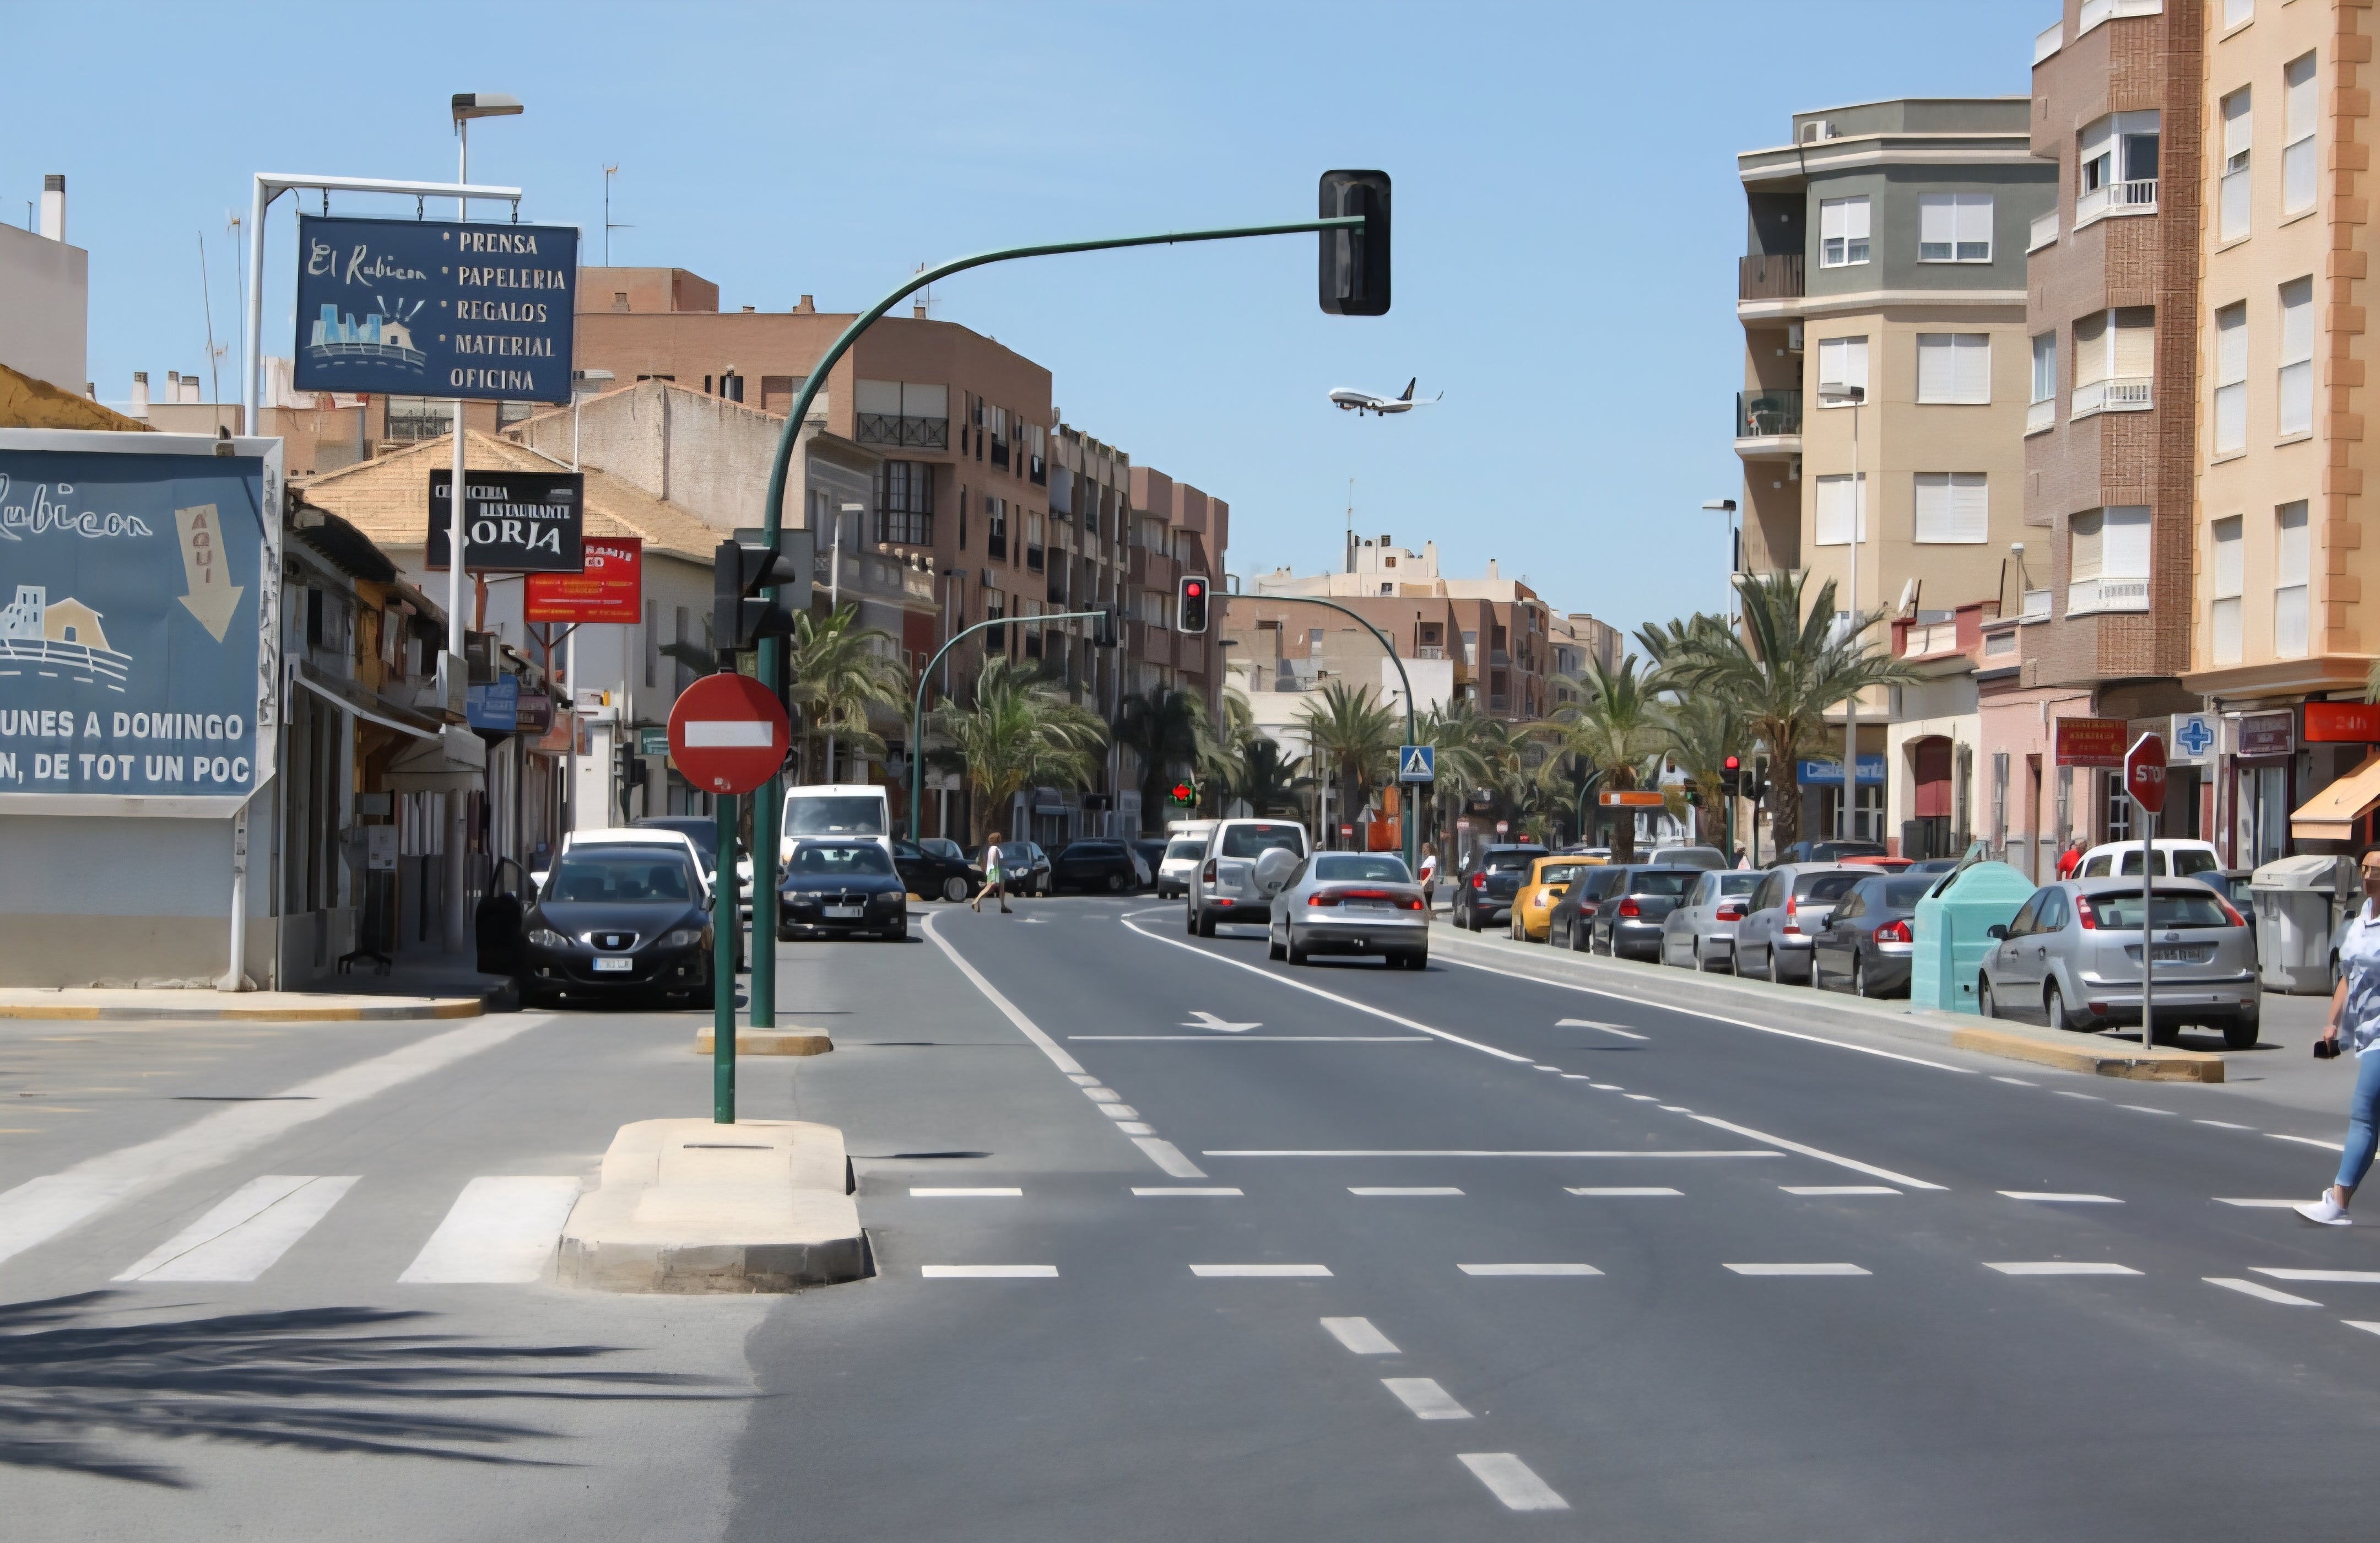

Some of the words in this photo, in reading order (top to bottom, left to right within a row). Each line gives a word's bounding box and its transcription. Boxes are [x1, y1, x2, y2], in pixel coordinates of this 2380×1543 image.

[460, 232, 537, 255] PRENSA
[308, 238, 337, 277] El
[458, 266, 565, 290] PAPELERIA
[458, 300, 547, 323] REGALOS
[456, 334, 555, 357] MATERIAL
[451, 368, 534, 391] OFICINA
[0, 710, 73, 737] UNES
[84, 711, 101, 738] A
[113, 711, 243, 740] DOMINGO
[35, 754, 69, 779] DE
[79, 754, 135, 783] TOT
[145, 755, 183, 782] UN
[193, 756, 249, 783] POC
